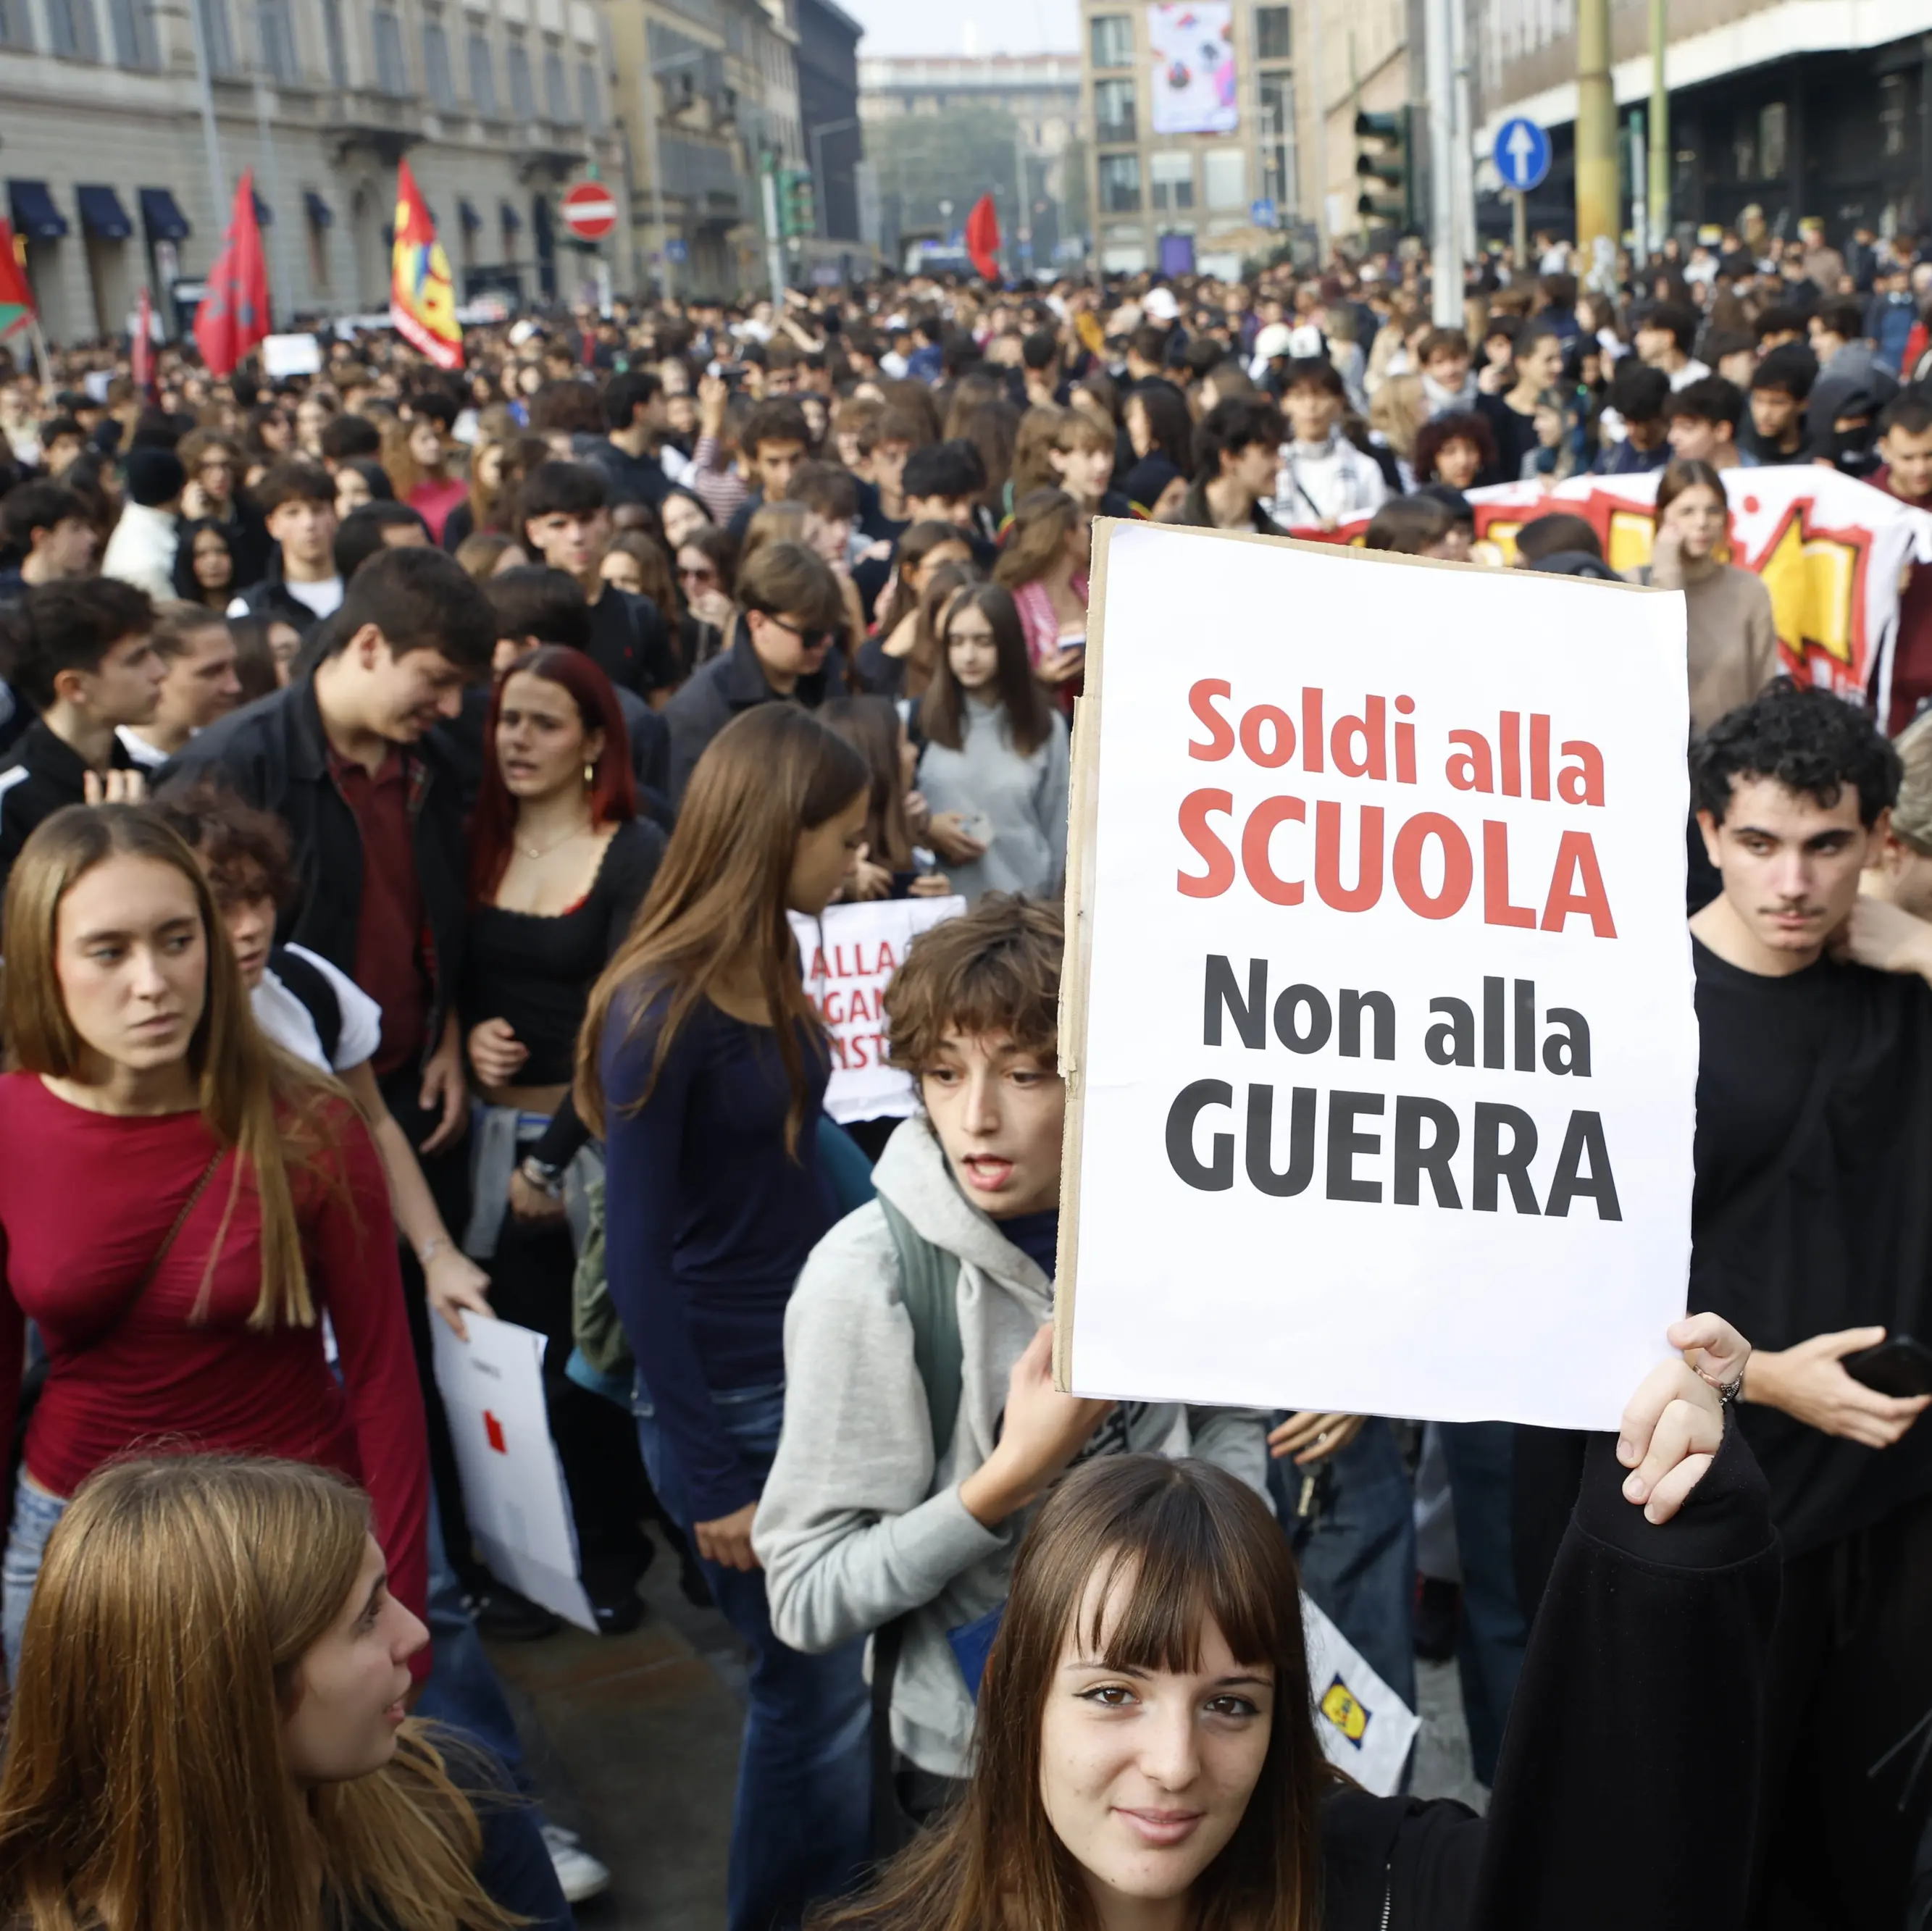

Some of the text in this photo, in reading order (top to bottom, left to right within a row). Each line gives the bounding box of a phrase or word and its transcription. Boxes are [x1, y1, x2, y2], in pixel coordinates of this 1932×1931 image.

[1189, 679, 1605, 807] Soldi alla
[1177, 788, 1618, 939] SCUOLA
[810, 941, 896, 980] ALLA
[1203, 954, 1592, 1078] Non alla
[1165, 1078, 1623, 1222] GUERRA
